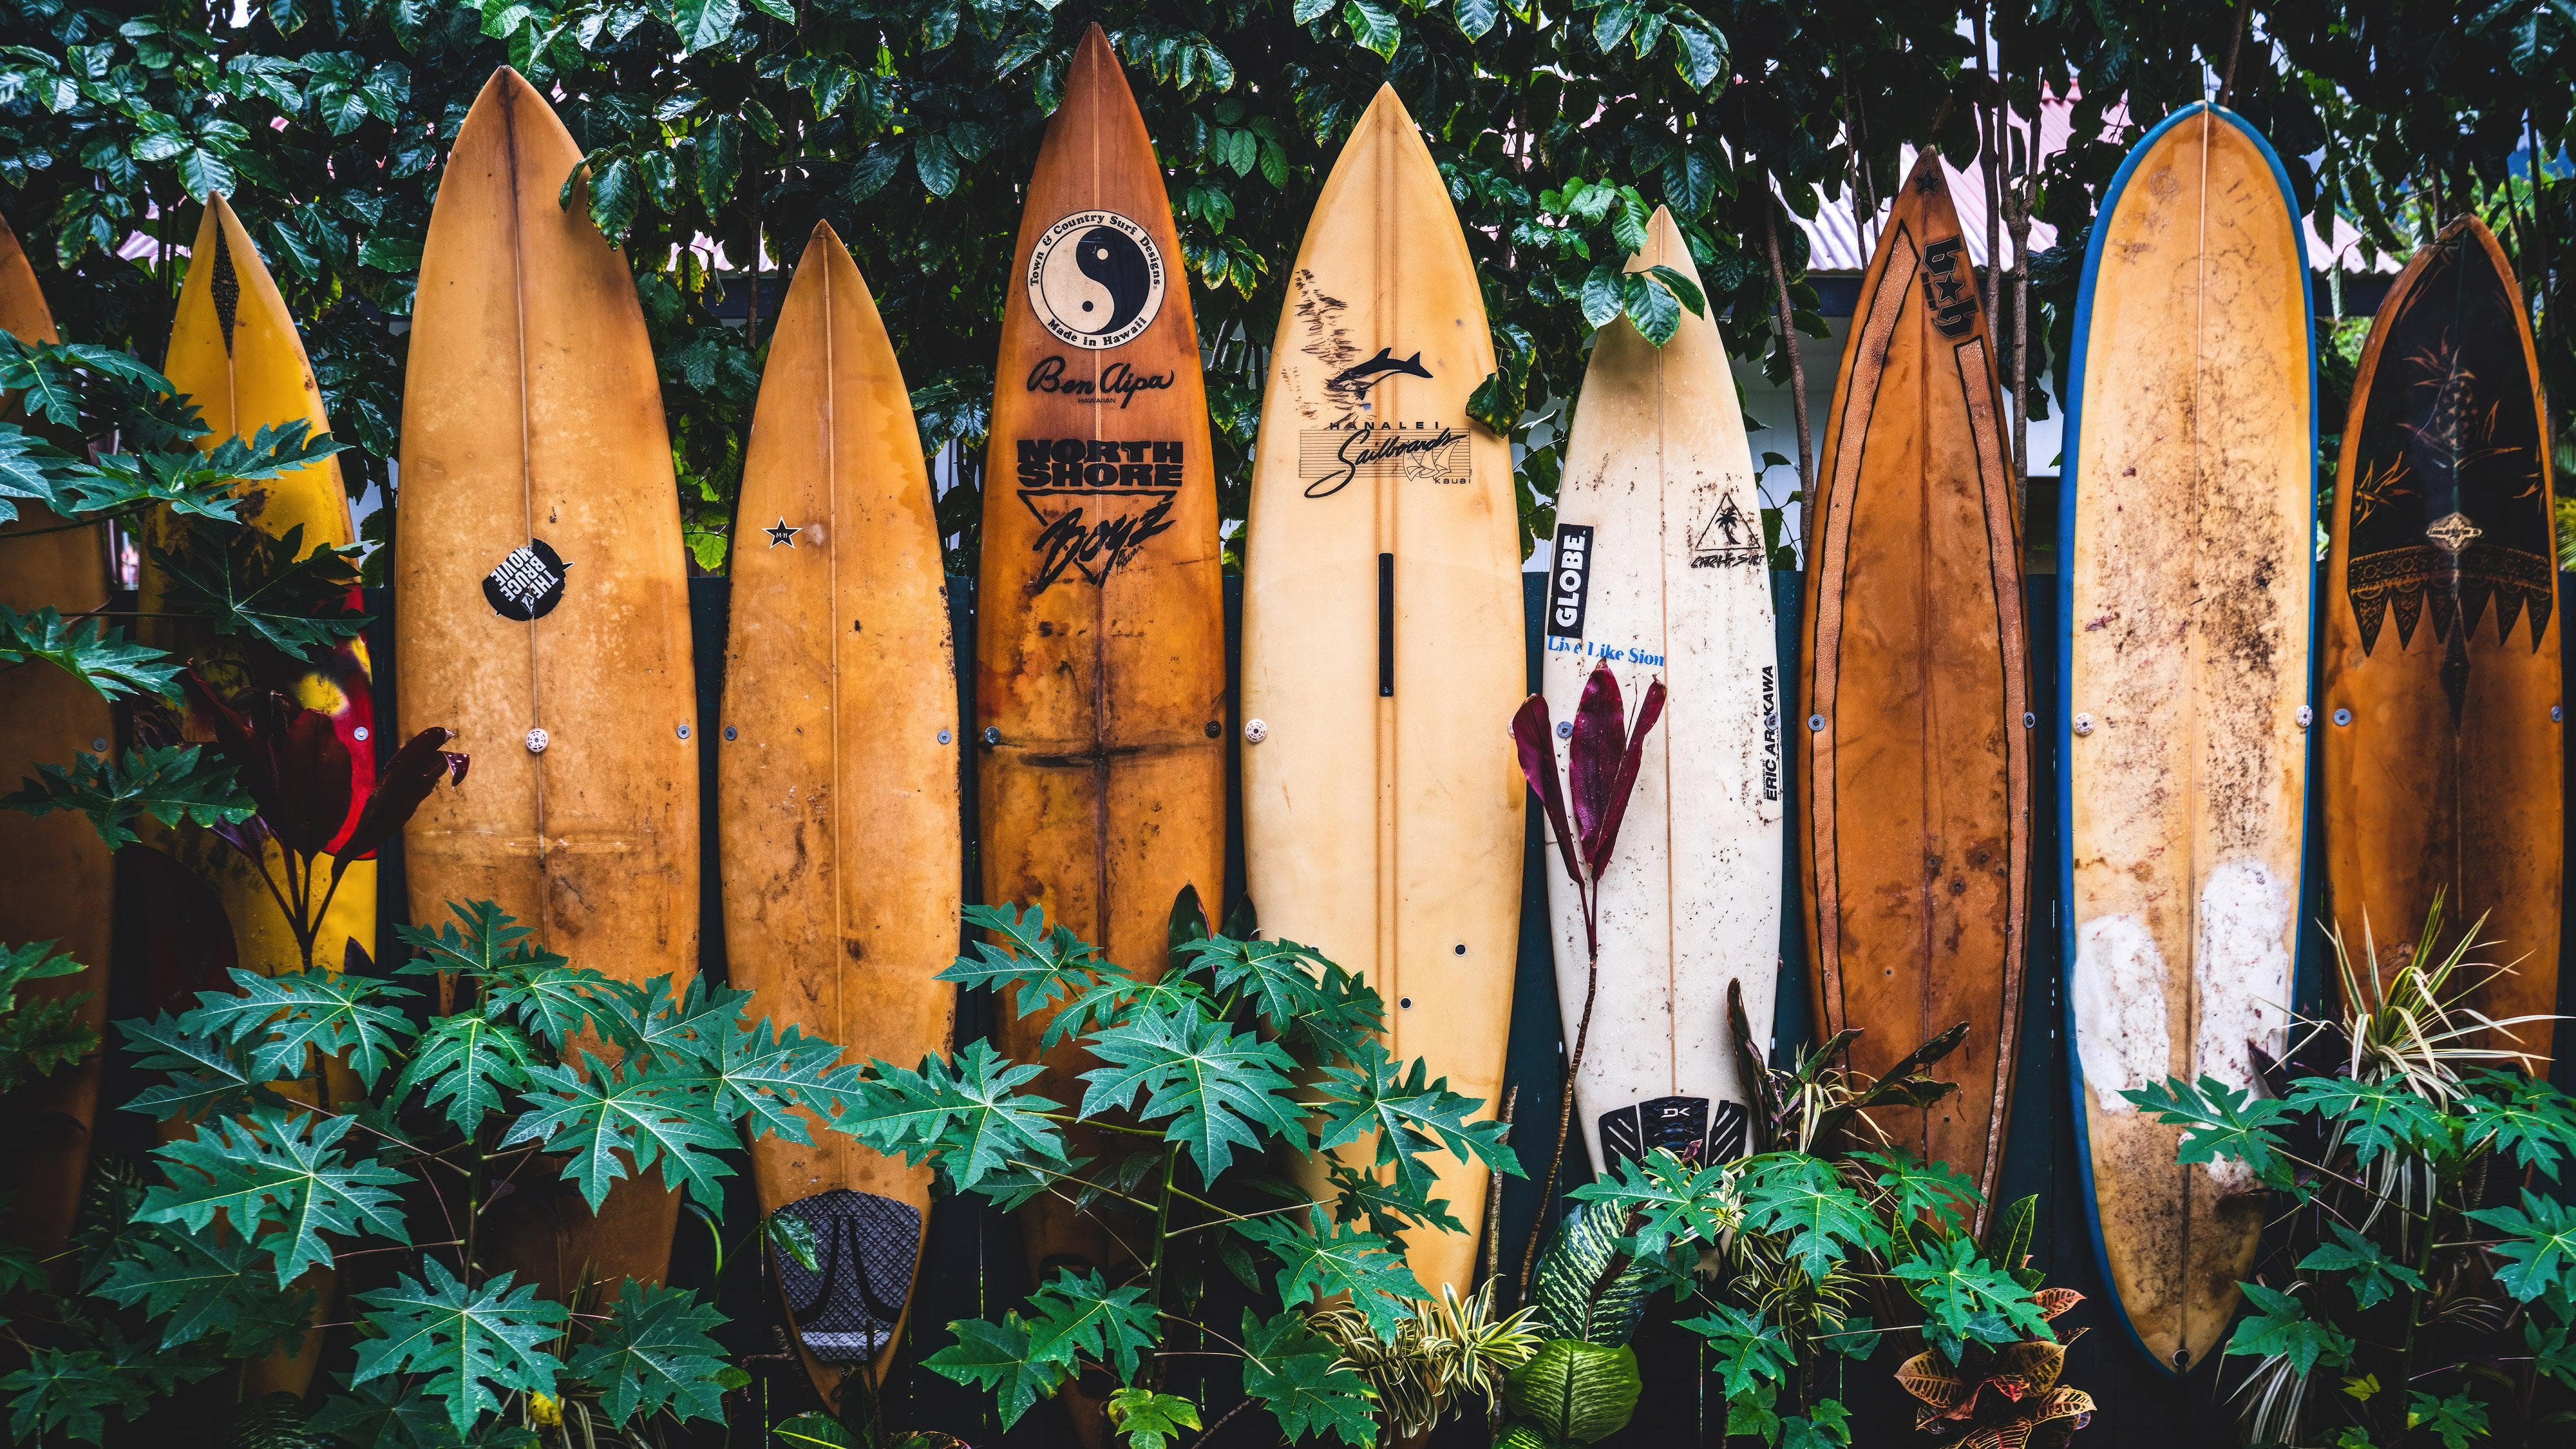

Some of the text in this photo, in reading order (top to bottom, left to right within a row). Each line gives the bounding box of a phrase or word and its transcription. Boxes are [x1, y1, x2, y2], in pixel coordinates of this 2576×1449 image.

[1030, 251, 1044, 286] Town
[1043, 235, 1052, 246] &
[1053, 214, 1105, 235] Country
[1109, 216, 1137, 235] Surf
[1047, 316, 1147, 346] Made in Hawaii
[1027, 355, 1174, 409] Ben Aipa
[1330, 421, 1439, 429] HANALEI
[1017, 439, 1183, 463] NORTH
[1304, 427, 1467, 498] Sailboards
[1017, 462, 1184, 487] SHORE
[490, 547, 534, 587] MOVIE
[1032, 501, 1176, 594] Boyz
[500, 555, 547, 602] BRUCE
[527, 570, 559, 599] THE
[1555, 535, 1585, 627] GLOBE
[1628, 647, 1664, 667] Sion
[1762, 665, 1777, 802] ERIC ARKAWA
